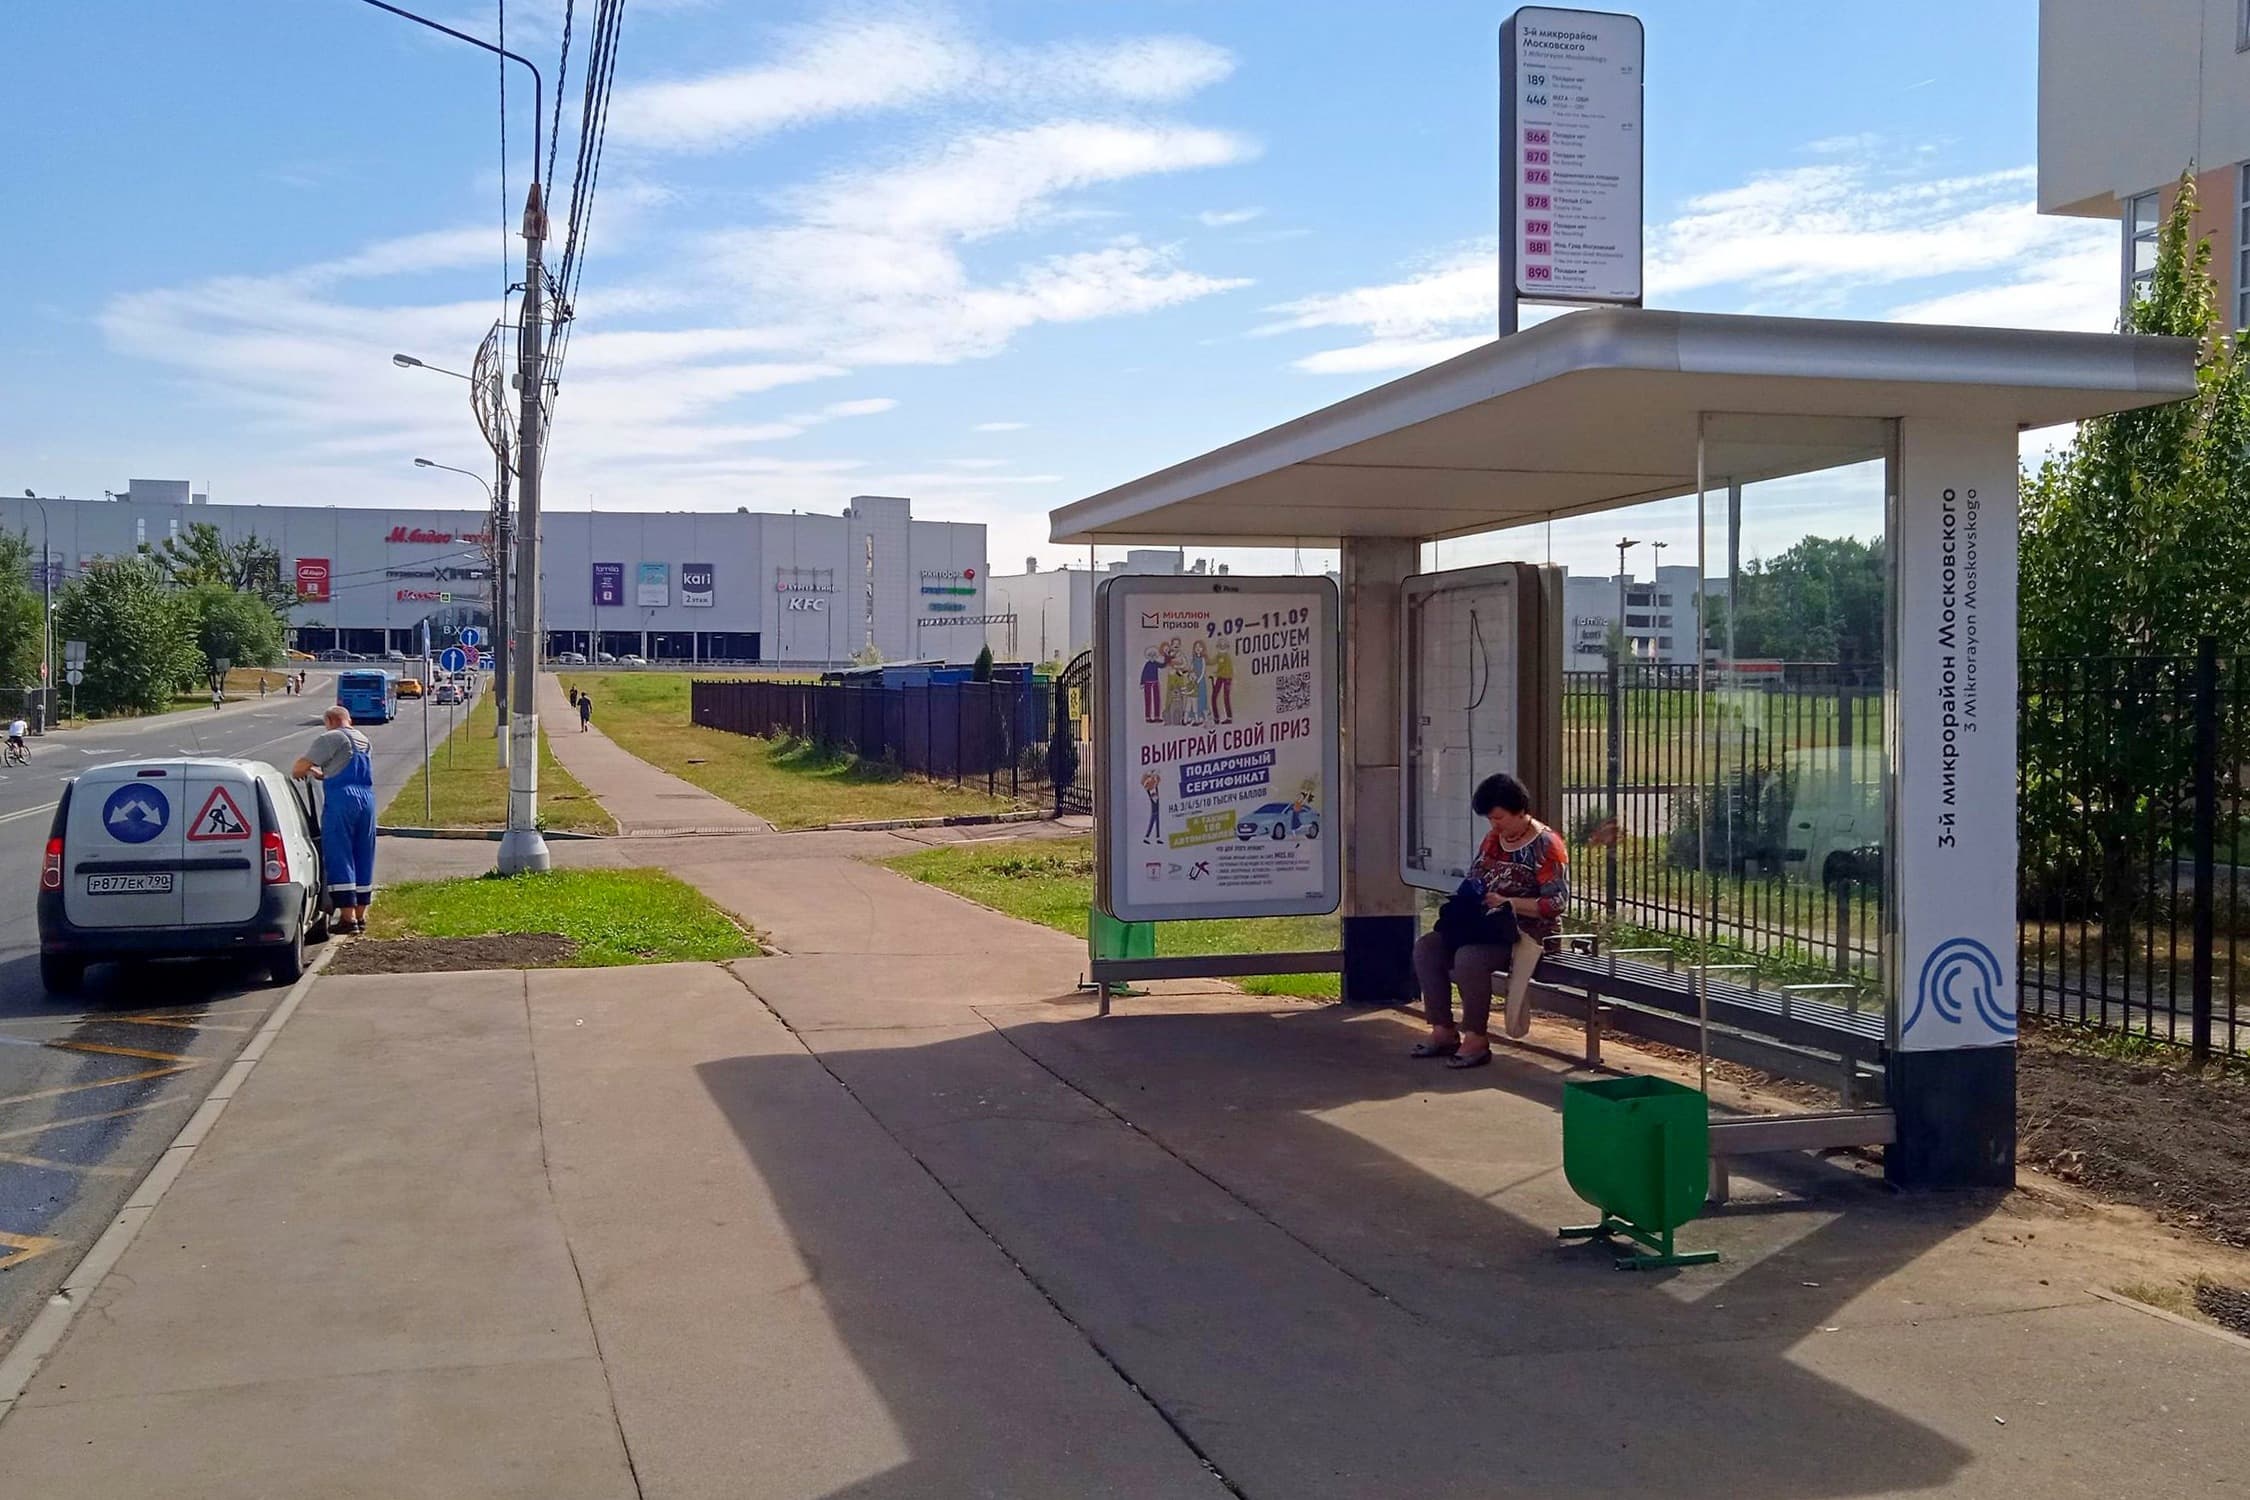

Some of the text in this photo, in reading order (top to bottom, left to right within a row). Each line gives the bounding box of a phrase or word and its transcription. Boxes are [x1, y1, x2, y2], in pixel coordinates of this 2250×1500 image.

[1523, 27, 1598, 41] 3-й микрорайон
[1523, 38, 1585, 51] Московского
[1528, 74, 1545, 85] 189
[1526, 94, 1547, 105] 446
[1527, 131, 1547, 142] 866
[1527, 151, 1547, 162] 870
[1527, 171, 1547, 182] 876
[1527, 197, 1548, 208] 878
[1527, 222, 1548, 233] 879
[1529, 242, 1547, 253] 881
[1528, 268, 1549, 278] 890
[683, 573, 711, 585] kari
[788, 598, 825, 611] KFC
[1964, 488, 1981, 733] 3 Mikrorayon Moskovskogo
[1235, 627, 1310, 656] ГОЛОСУЕМ
[1252, 647, 1310, 675] ОНЛАЙН
[1938, 487, 1960, 849] 3-й микрорайон Московского
[1141, 717, 1310, 765] ВЫИГРАЙ СВОЙ ПРИЗ
[1186, 752, 1271, 777] ПОДАРОЧНЫЙ
[1186, 770, 1266, 793] СЕРТИФИКАТ
[1168, 788, 1267, 813] НА 3/4/5/10 ТЫСЯЧ БАЛЛОВ
[93, 875, 168, 890] Р877ЕК 790
